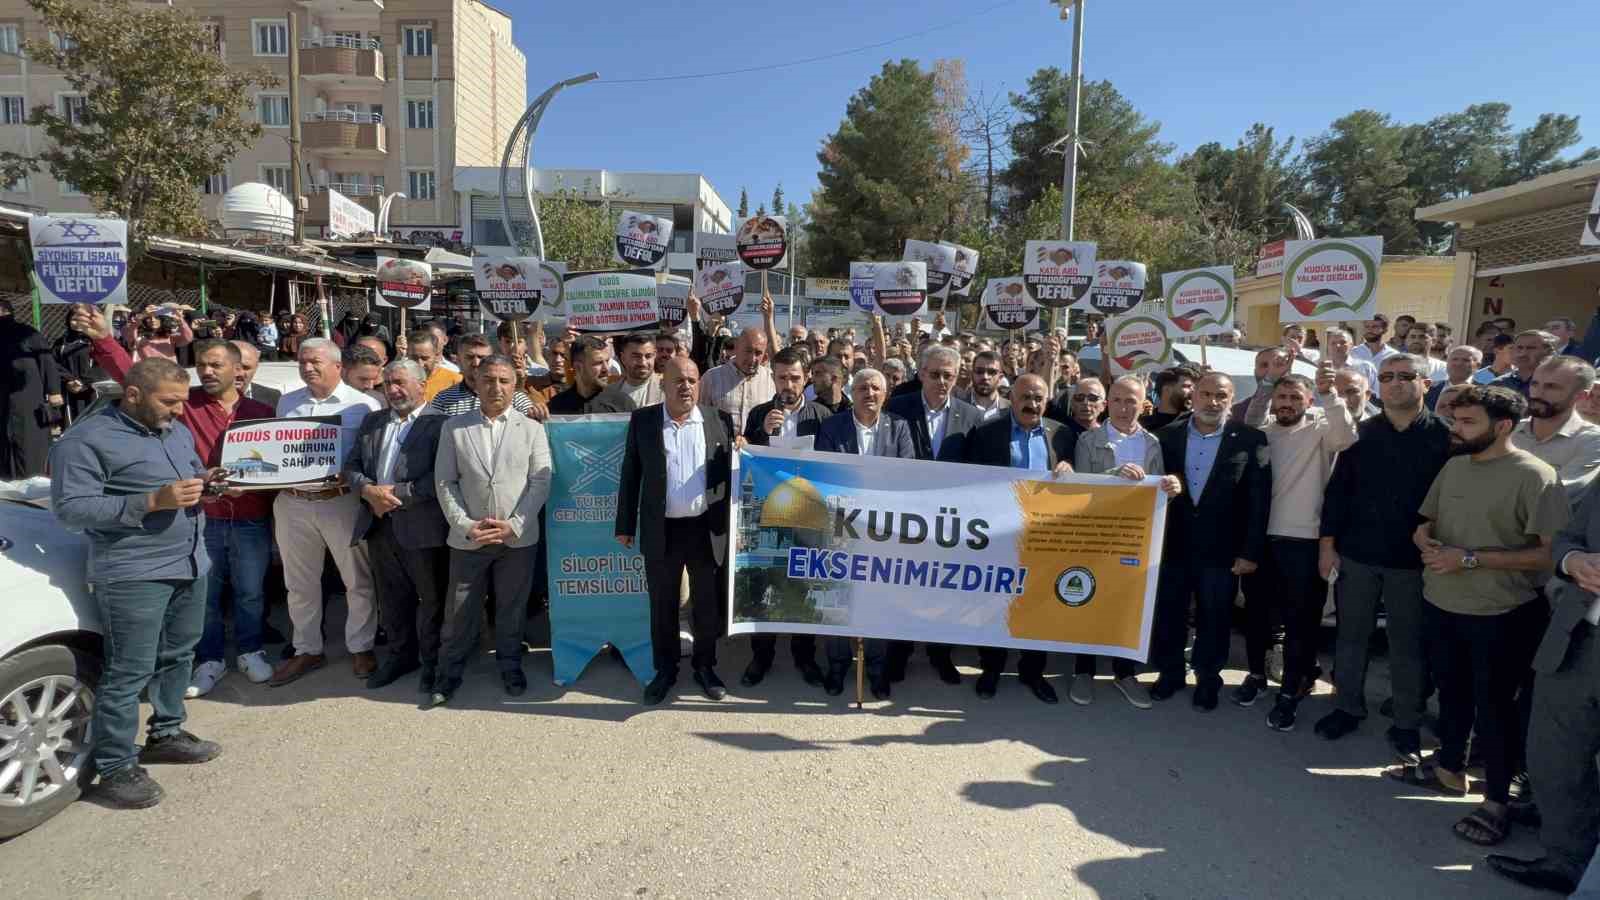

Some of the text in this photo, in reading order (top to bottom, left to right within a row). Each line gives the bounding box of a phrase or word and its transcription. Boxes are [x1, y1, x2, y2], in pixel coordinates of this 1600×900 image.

[55, 277, 107, 292] DEFOL
[1037, 285, 1076, 300] DEFOL
[491, 299, 530, 314] DEFOL
[1096, 294, 1130, 307] DEFOL
[658, 307, 683, 321] AYIR!
[997, 311, 1028, 323] DEFOL
[227, 428, 337, 443] KUDÜS ONURDUR
[283, 443, 335, 454] ONURUNA
[282, 456, 315, 468] SAHİP
[575, 494, 617, 508] TÜRKİ
[833, 506, 990, 550] KUDÜS
[562, 552, 644, 576] SİLOPİ İLÇ
[788, 547, 1027, 594] EKSENİMİZDİR!
[556, 575, 649, 595] TEMSİLCİLİ
